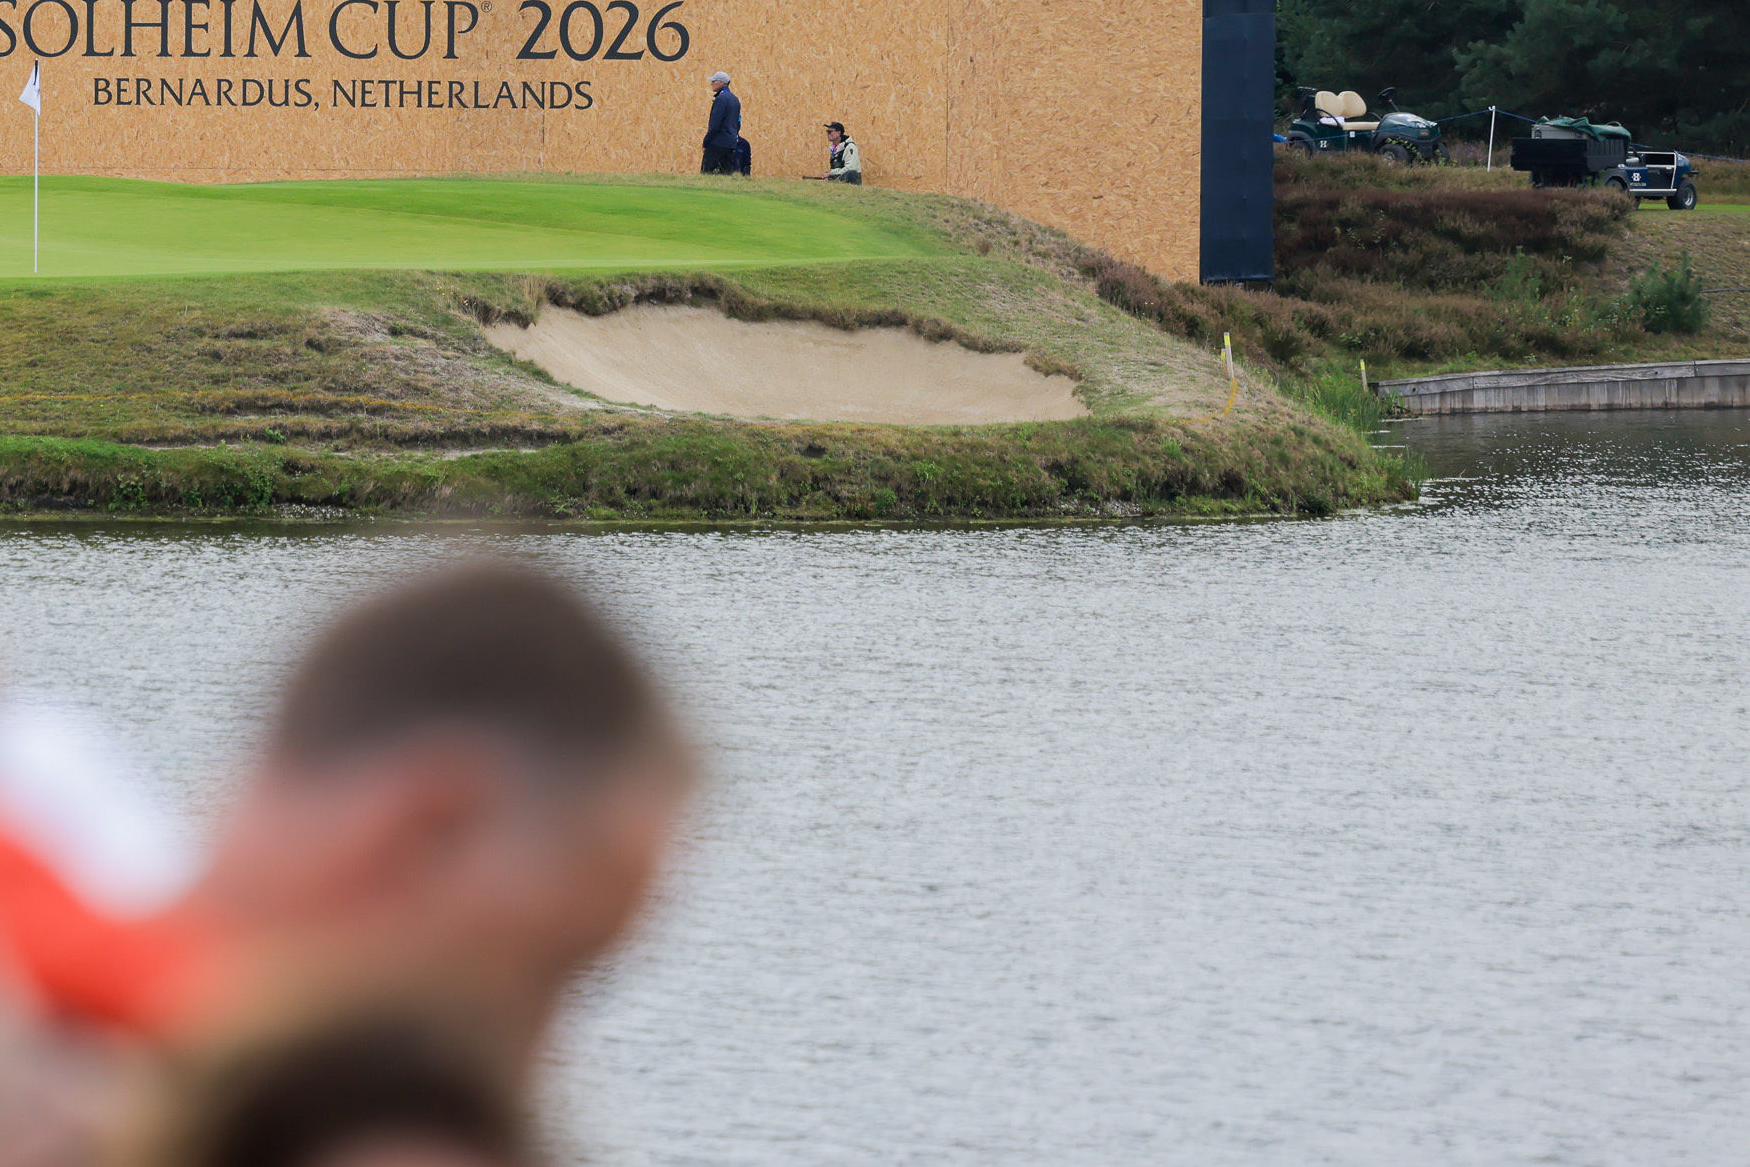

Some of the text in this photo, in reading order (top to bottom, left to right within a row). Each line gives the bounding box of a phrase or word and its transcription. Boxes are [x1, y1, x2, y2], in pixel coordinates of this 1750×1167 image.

[515, 0, 690, 62] 2026
[93, 77, 594, 112] BERNARDUS, NETHERLANDS
